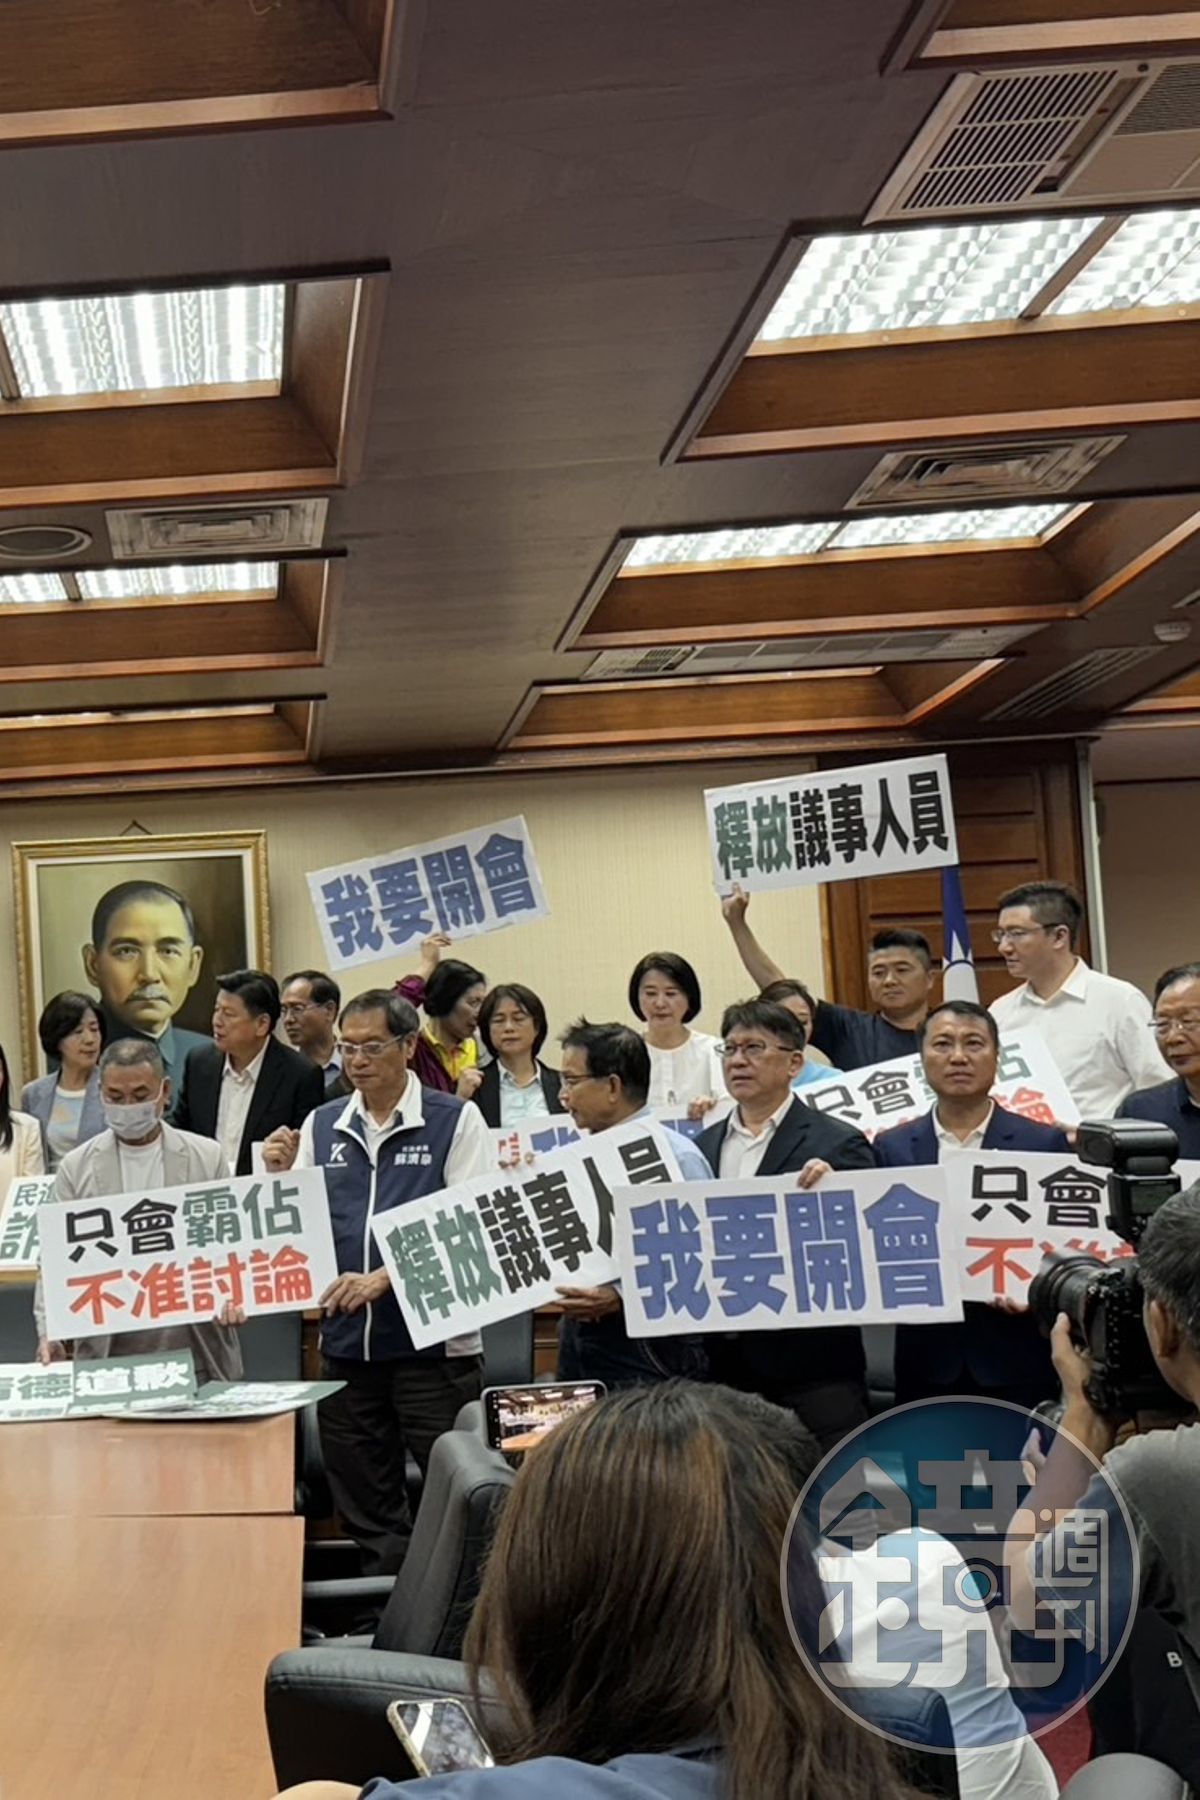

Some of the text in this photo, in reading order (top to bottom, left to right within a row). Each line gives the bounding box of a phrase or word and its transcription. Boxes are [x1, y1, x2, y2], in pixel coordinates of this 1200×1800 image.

[712, 769, 949, 881] 釋放議事人員
[319, 832, 538, 958] 我要開會
[65, 1180, 303, 1263] 只會霸佔
[629, 1183, 946, 1322] 我要開會
[66, 1244, 313, 1326] 不准討論
